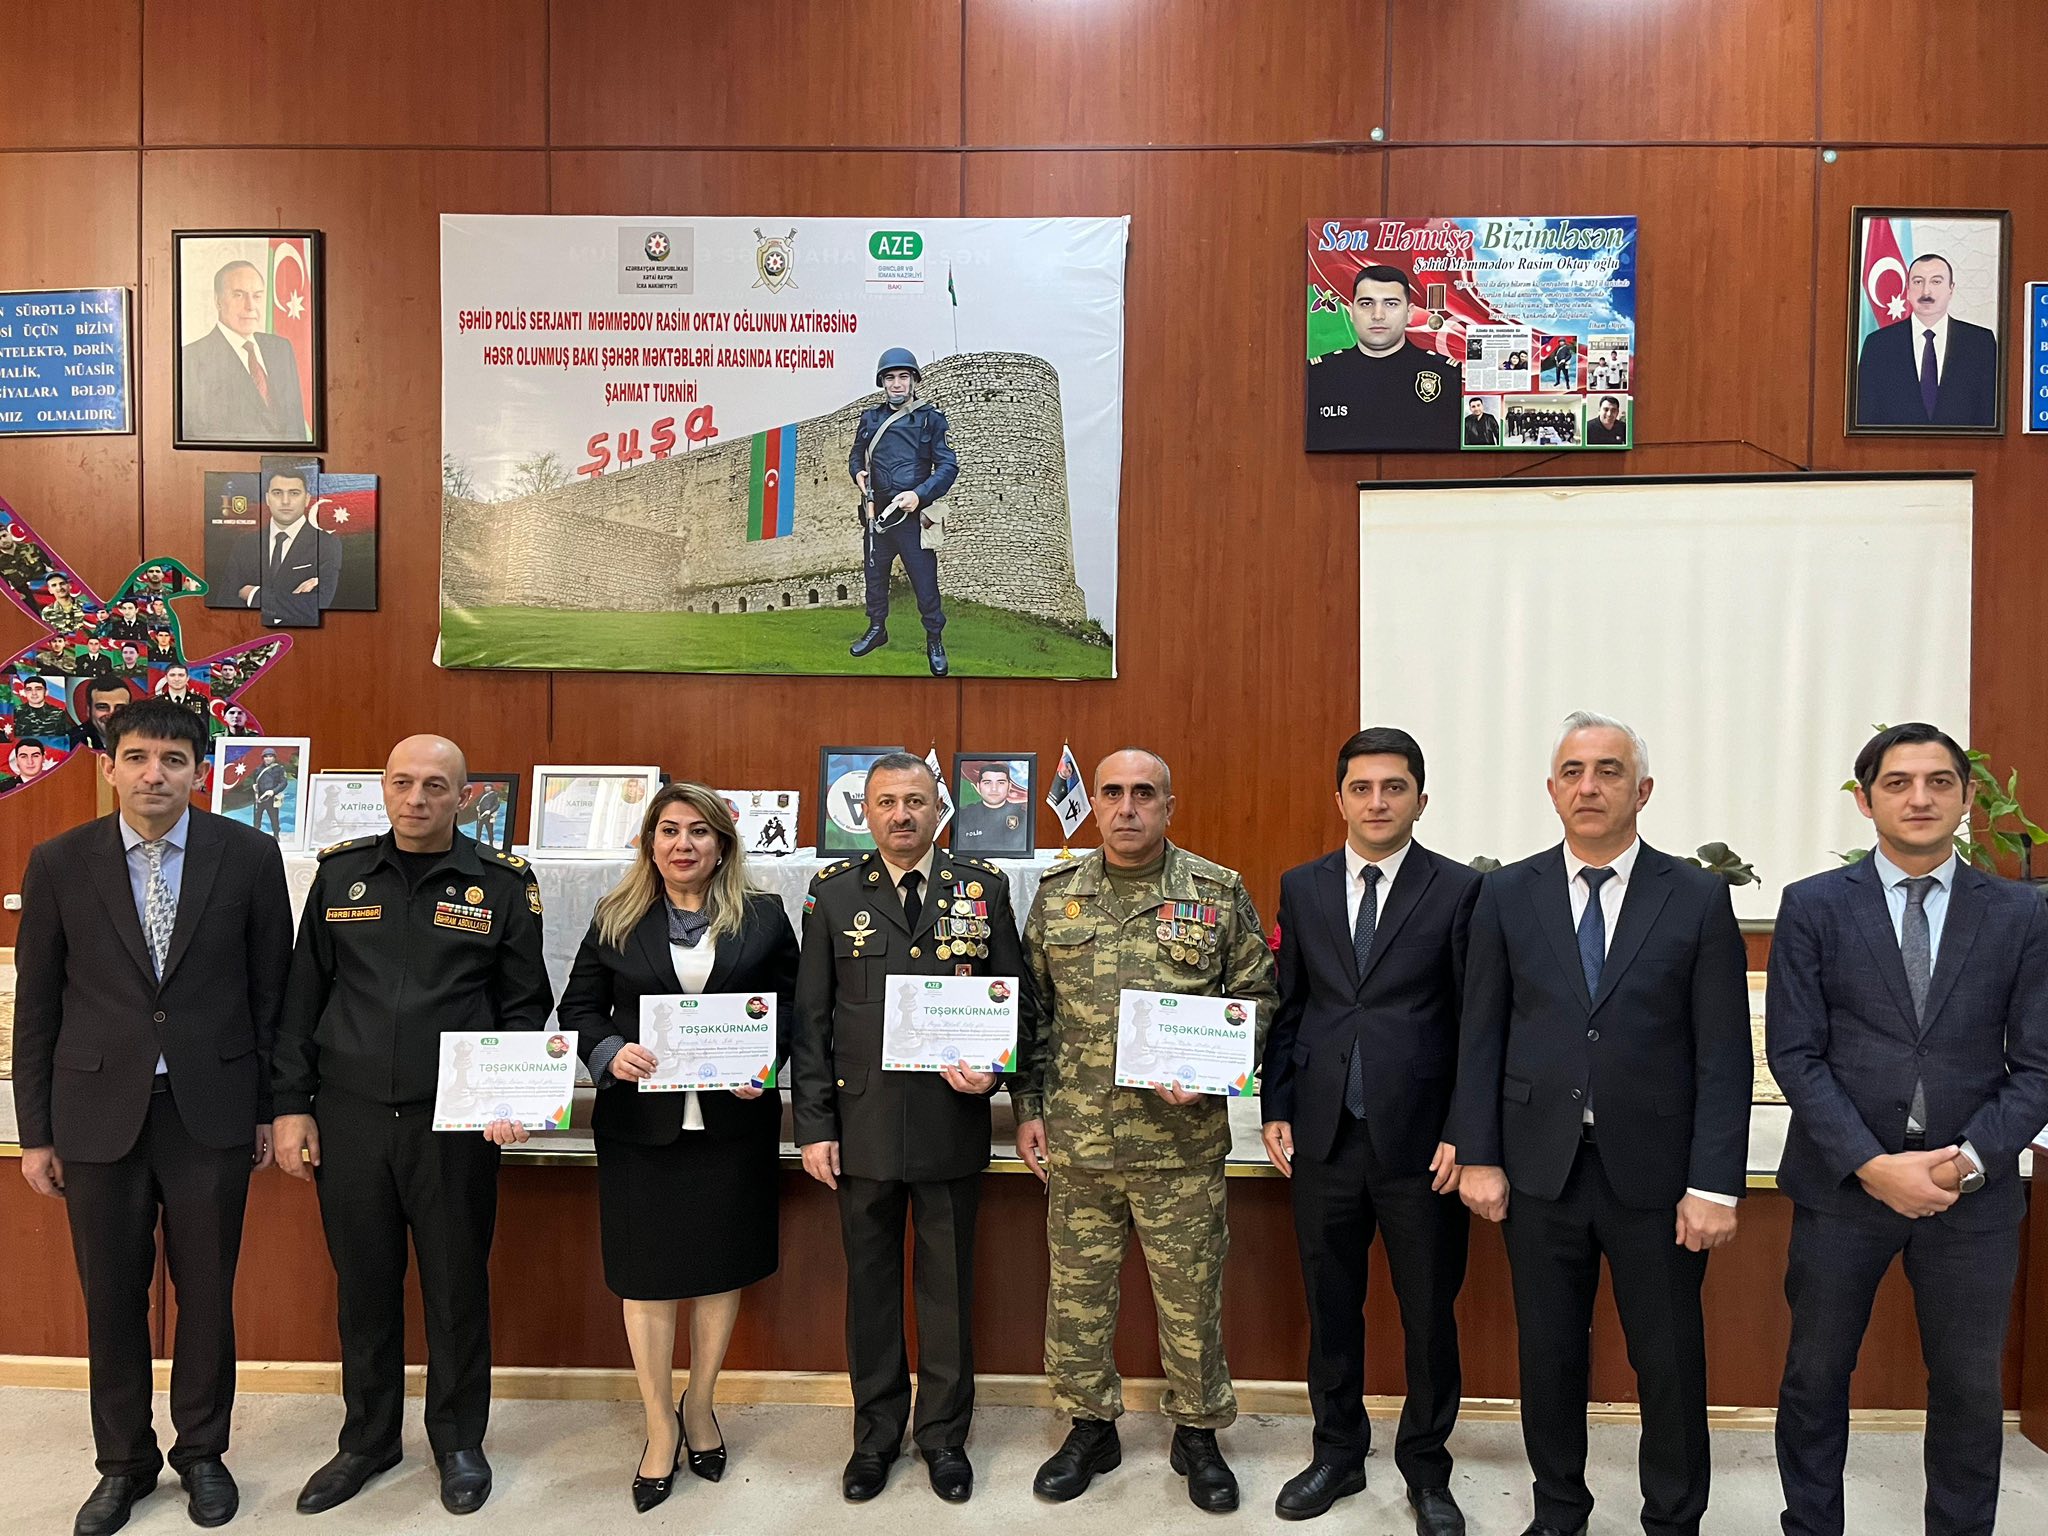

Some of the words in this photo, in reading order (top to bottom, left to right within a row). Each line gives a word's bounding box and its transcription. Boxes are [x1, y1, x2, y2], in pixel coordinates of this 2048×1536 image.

[878, 236, 914, 255] AZE
[1318, 221, 1368, 251] Sən
[1374, 221, 1475, 257] Həmişə
[1481, 220, 1624, 251] Bizimləsən
[1414, 256, 1447, 275] Şəhid
[1448, 257, 1514, 272] Məmmədov
[1518, 257, 1552, 270] Rasim
[1557, 256, 1590, 272] Oktay
[1594, 256, 1619, 272] oğlu
[16, 304, 75, 316] SÜRƏTLƏ
[459, 306, 492, 334] ŞƏHİD
[496, 307, 526, 330] POLİS
[529, 311, 582, 331] SERJANTI
[588, 312, 653, 332] MƏMMƏDOV
[656, 308, 690, 332] RASİM
[694, 312, 731, 332] OKTAY
[734, 309, 787, 332] OĞLUNUN
[790, 309, 857, 333] XATİRƏSİNƏ
[23, 324, 58, 338] ÜÇÜN
[76, 321, 114, 336] BİZİM
[74, 342, 114, 356] DƏRİN
[484, 346, 514, 366] HƏSR
[516, 346, 570, 371] OLUNMUŞ
[572, 347, 598, 366] BAKI
[602, 347, 639, 371] ŞƏHƏR
[642, 344, 714, 368] MƏKTƏBLƏRİ
[716, 349, 772, 368] ARASINDA
[775, 345, 834, 373] KEÇİRİLƏN
[64, 362, 115, 377] MÜASİR
[72, 384, 116, 397] BƏLƏD
[605, 383, 650, 406] ŞAHMAT
[653, 379, 698, 403] TURNİRİ
[37, 409, 117, 422] OLMALIDIR.
[340, 802, 374, 811] XATİRƏ
[924, 1005, 1010, 1018] TƏŞƏKKÜRNAMƏ
[679, 1023, 768, 1036] TƏŞƏKKÜRNAMƏ
[1158, 1024, 1247, 1039] TƏŞƏKKÜRNAMƏ
[480, 1062, 568, 1074] TƏŞƏKKÜRNAMƏ
